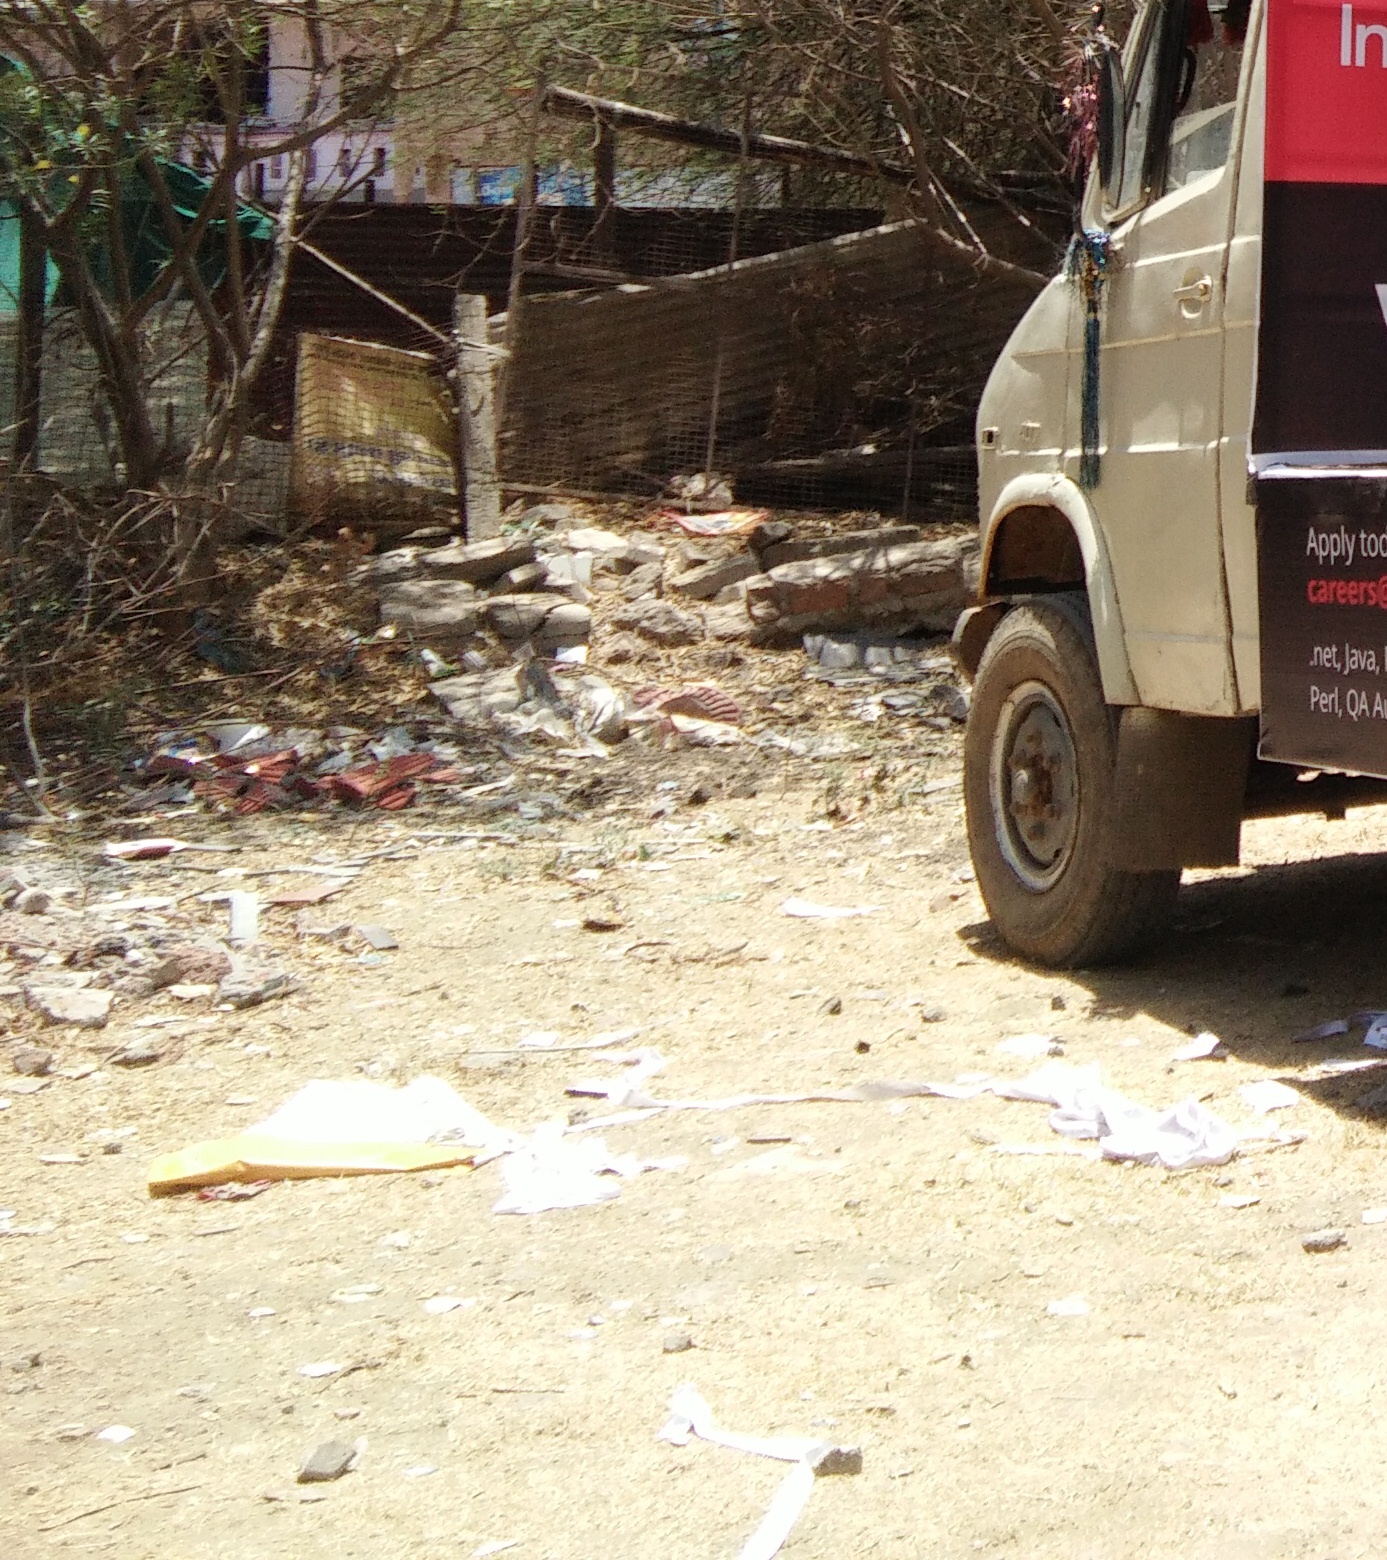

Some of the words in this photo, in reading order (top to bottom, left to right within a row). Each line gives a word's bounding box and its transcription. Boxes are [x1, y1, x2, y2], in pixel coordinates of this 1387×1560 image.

[1306, 525, 1356, 566] Apply
[1309, 643, 1341, 672] .net,
[1343, 642, 1380, 675] Java,
[1310, 685, 1342, 718] Perl,
[1346, 689, 1369, 721] QA
